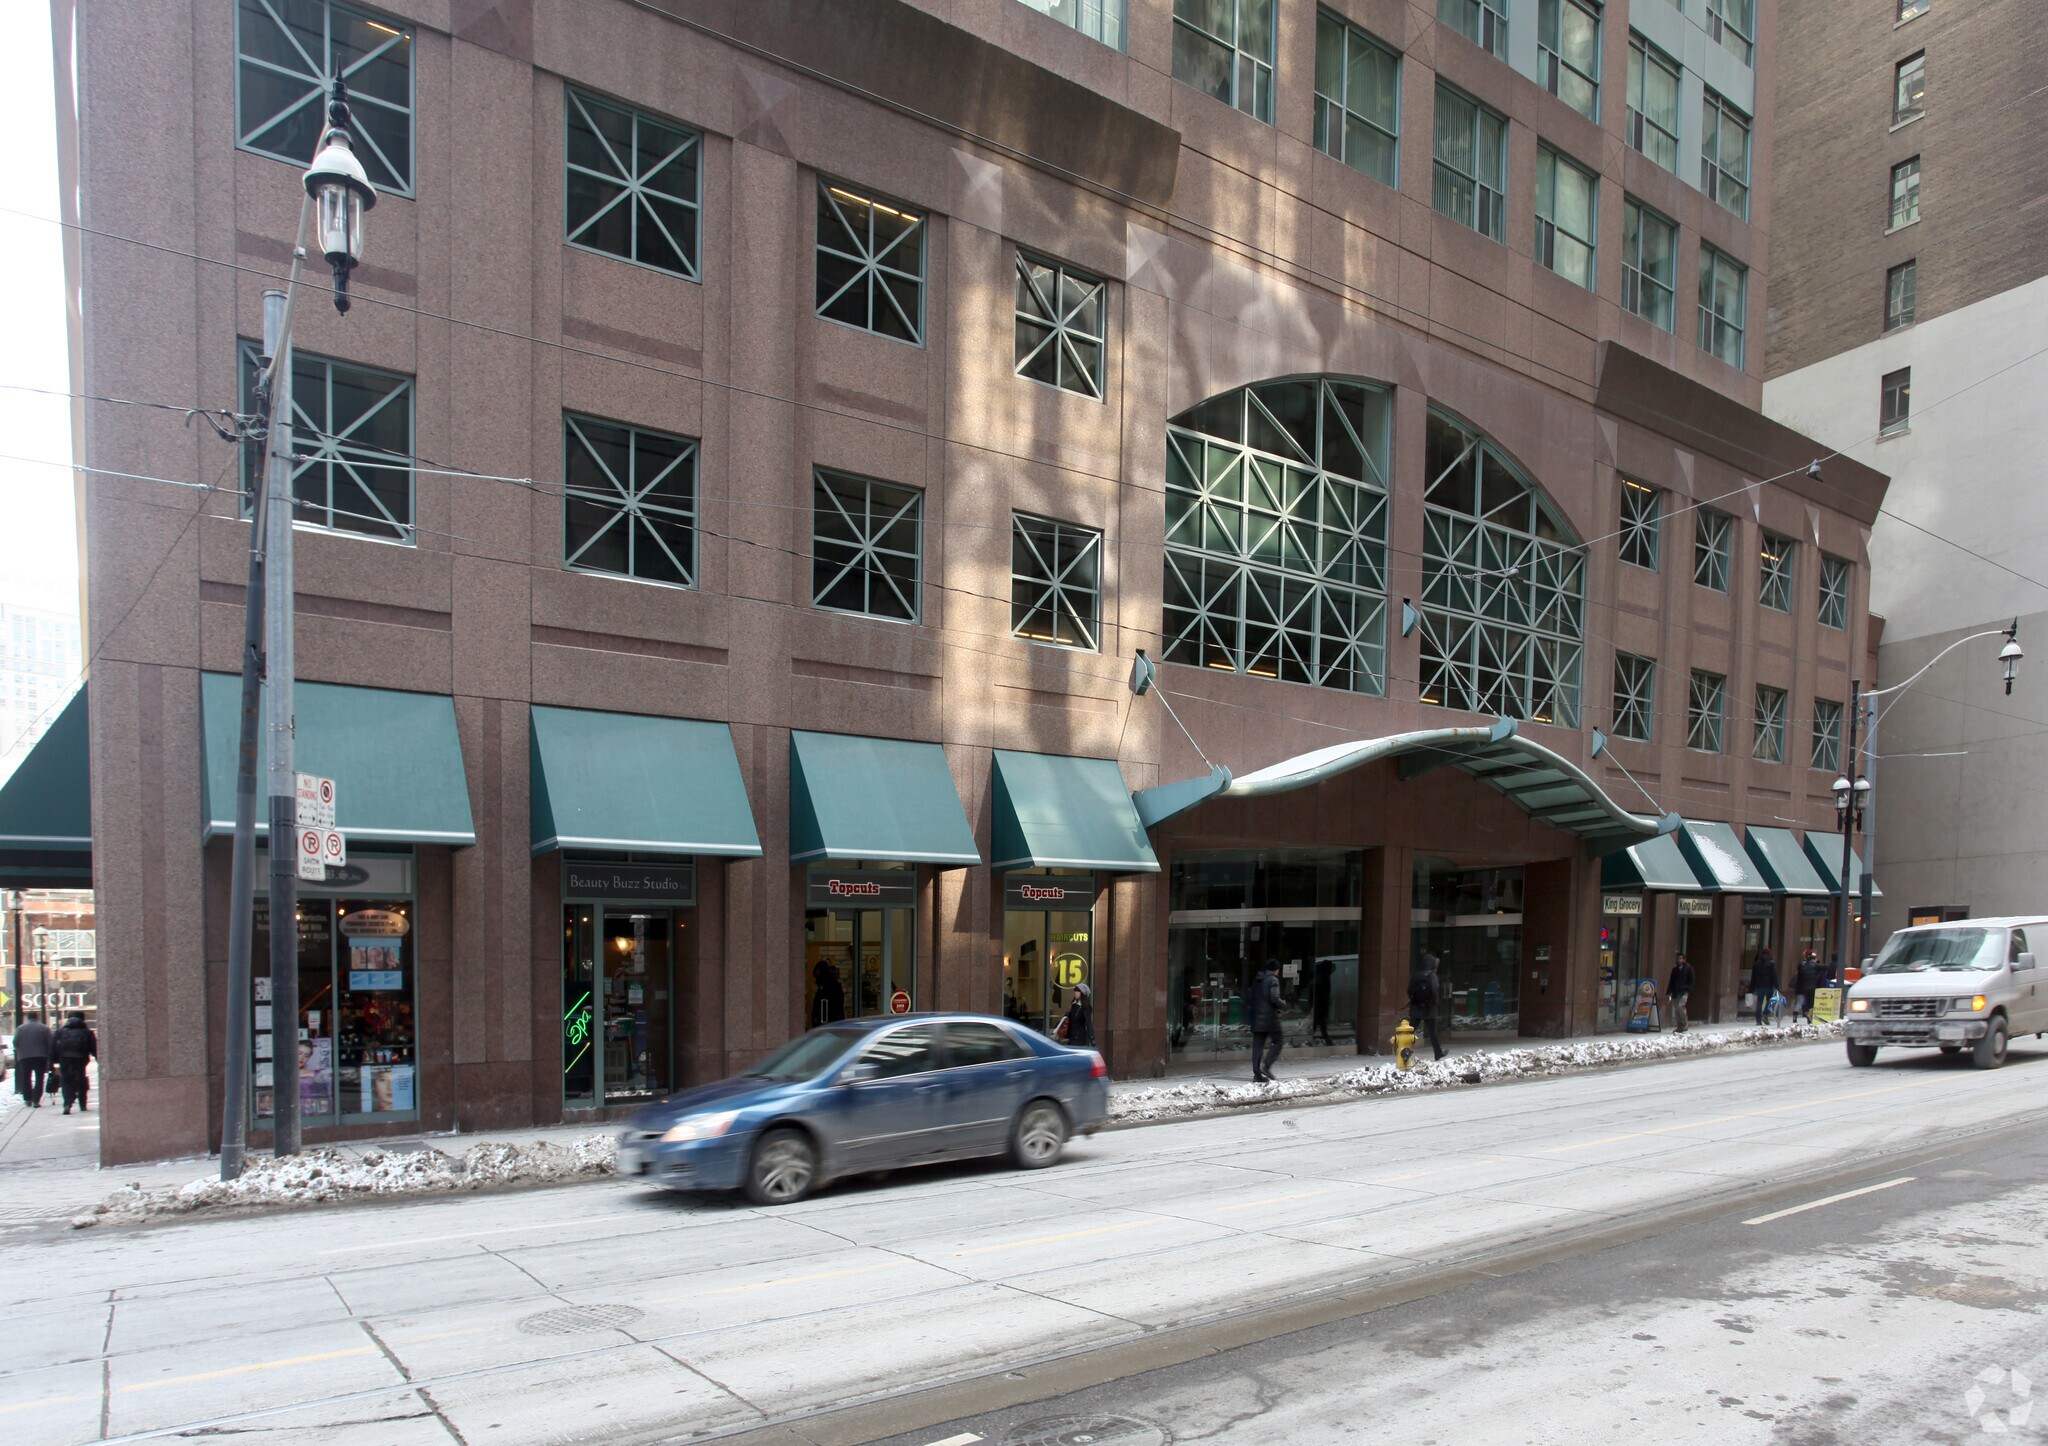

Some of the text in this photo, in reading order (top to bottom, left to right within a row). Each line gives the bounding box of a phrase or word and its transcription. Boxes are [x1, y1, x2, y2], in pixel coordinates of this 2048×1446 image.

[303, 778, 312, 789] NO
[297, 788, 318, 801] STANDING
[303, 856, 320, 866] SNOW
[302, 866, 322, 876] ROUTE
[570, 874, 610, 890] Beauty
[613, 875, 640, 890] Buzz
[643, 876, 679, 891] Studio
[829, 880, 880, 897] Topcuts
[1022, 885, 1065, 900] Topcuts
[1605, 898, 1641, 912] King Grocery
[1680, 900, 1711, 914] King Grocery
[1051, 933, 1088, 942] HAIRCUTS
[21, 992, 88, 1008] SCOTT
